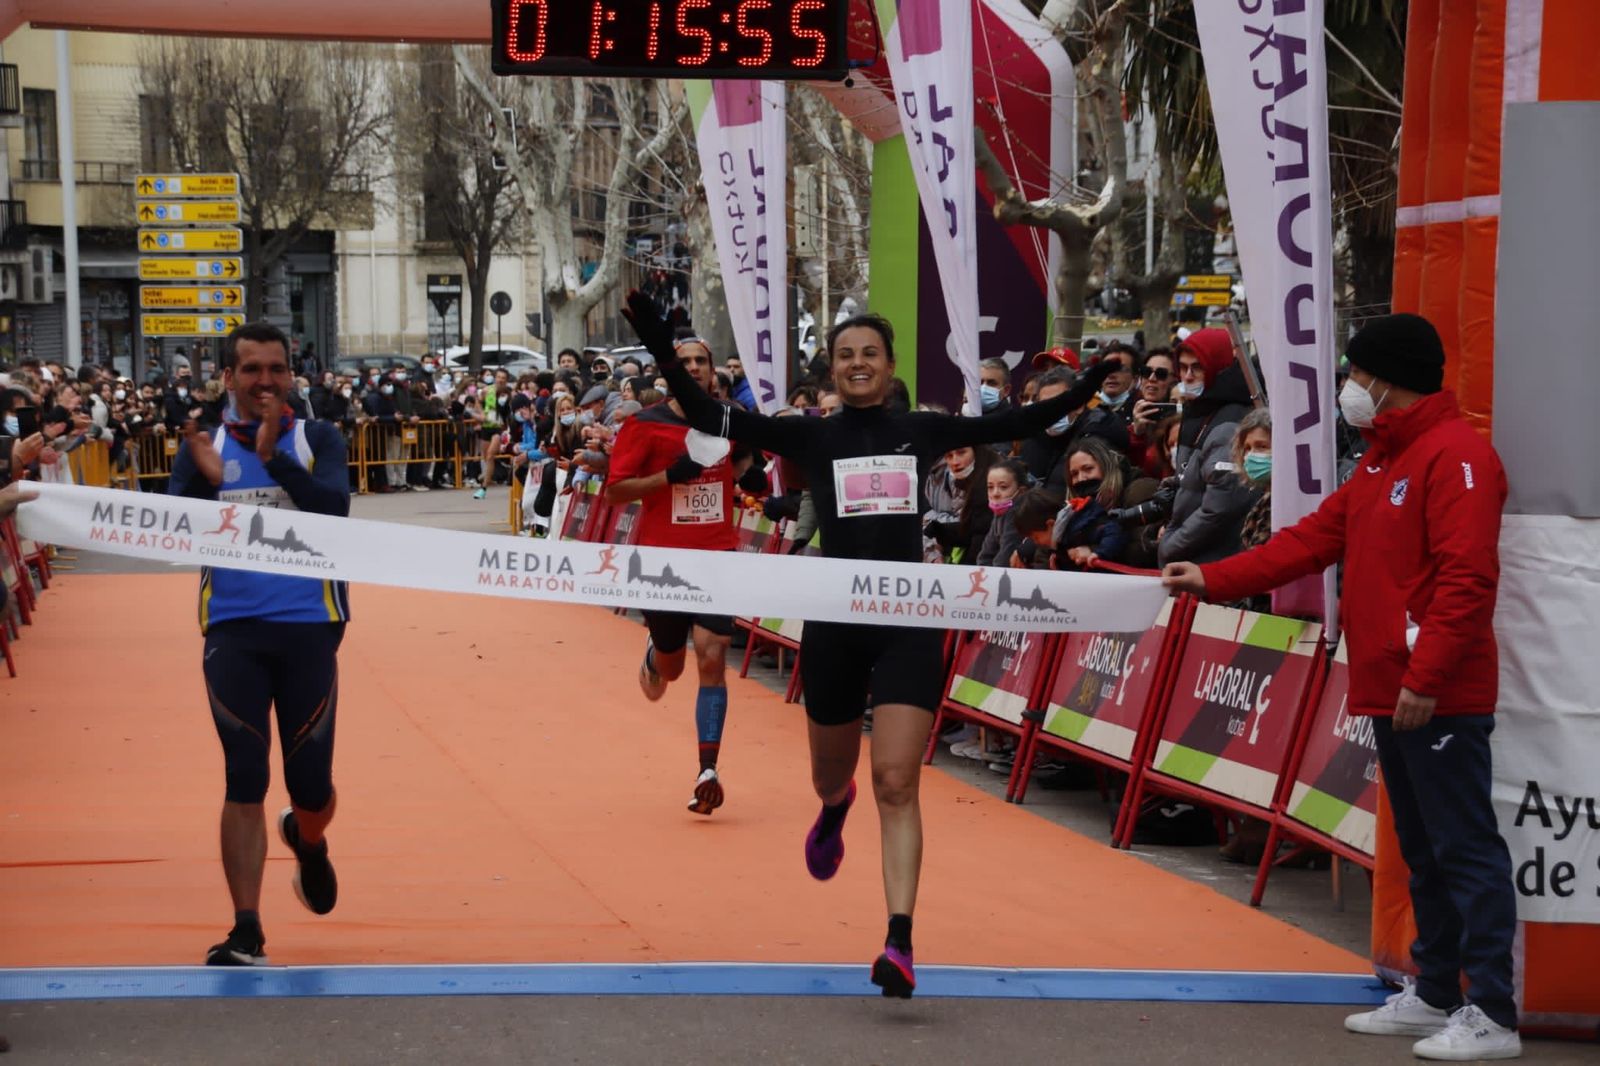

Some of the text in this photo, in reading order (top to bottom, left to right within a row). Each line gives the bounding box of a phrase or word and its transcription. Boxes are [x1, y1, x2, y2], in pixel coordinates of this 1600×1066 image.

[870, 472, 881, 491] 8
[684, 493, 717, 508] 1600
[91, 501, 193, 535] MEDIA
[90, 526, 192, 552] MARATÓN
[200, 546, 336, 569] CIUDAD DE SALAMANCA
[479, 548, 575, 576] MEDIA
[478, 571, 575, 593] MARATÓN
[851, 574, 945, 600] MEDIA
[581, 586, 713, 603] CIUDAD DE SALAMANCA
[850, 599, 945, 618] MARATÓN
[951, 609, 1078, 625] CIUDAD DE SALAMANCA
[1076, 634, 1120, 677] LABORAL
[1193, 660, 1256, 712] LABORAL
[1516, 846, 1576, 898] de
